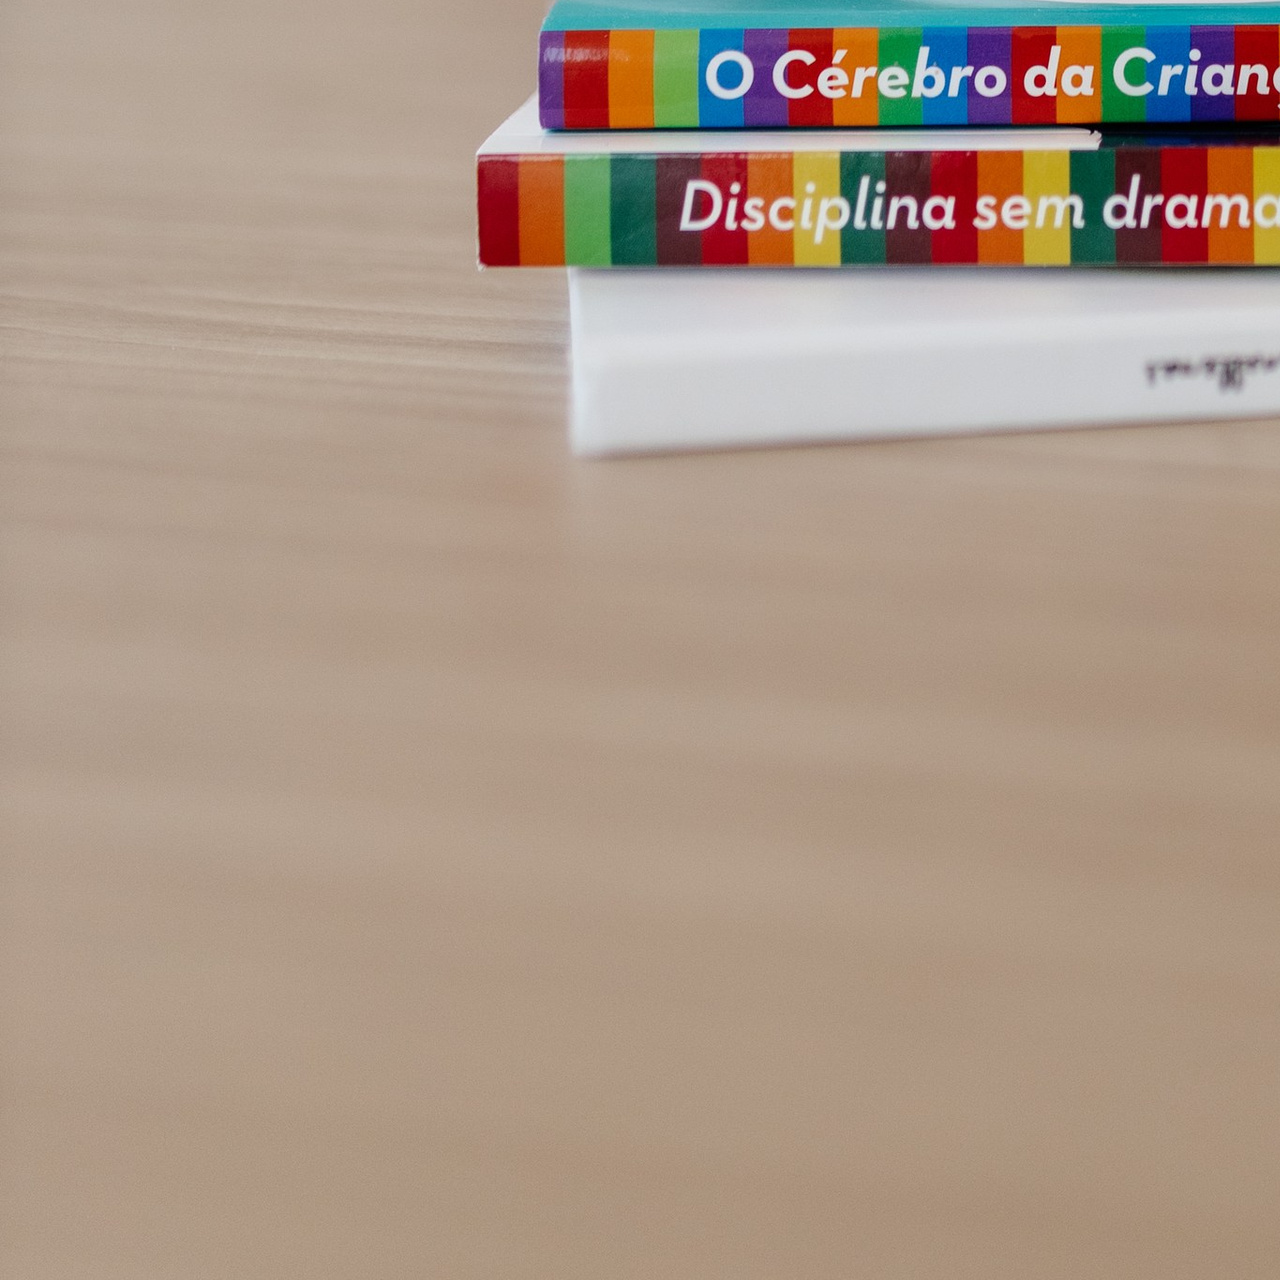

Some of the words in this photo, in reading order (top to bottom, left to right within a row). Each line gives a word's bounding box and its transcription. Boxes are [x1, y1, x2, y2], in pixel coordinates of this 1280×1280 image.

[705, 49, 755, 100] O
[772, 45, 1008, 100] Cérebro
[1022, 46, 1095, 98] da
[679, 177, 957, 244] Disciplina
[972, 192, 1087, 231] sem
